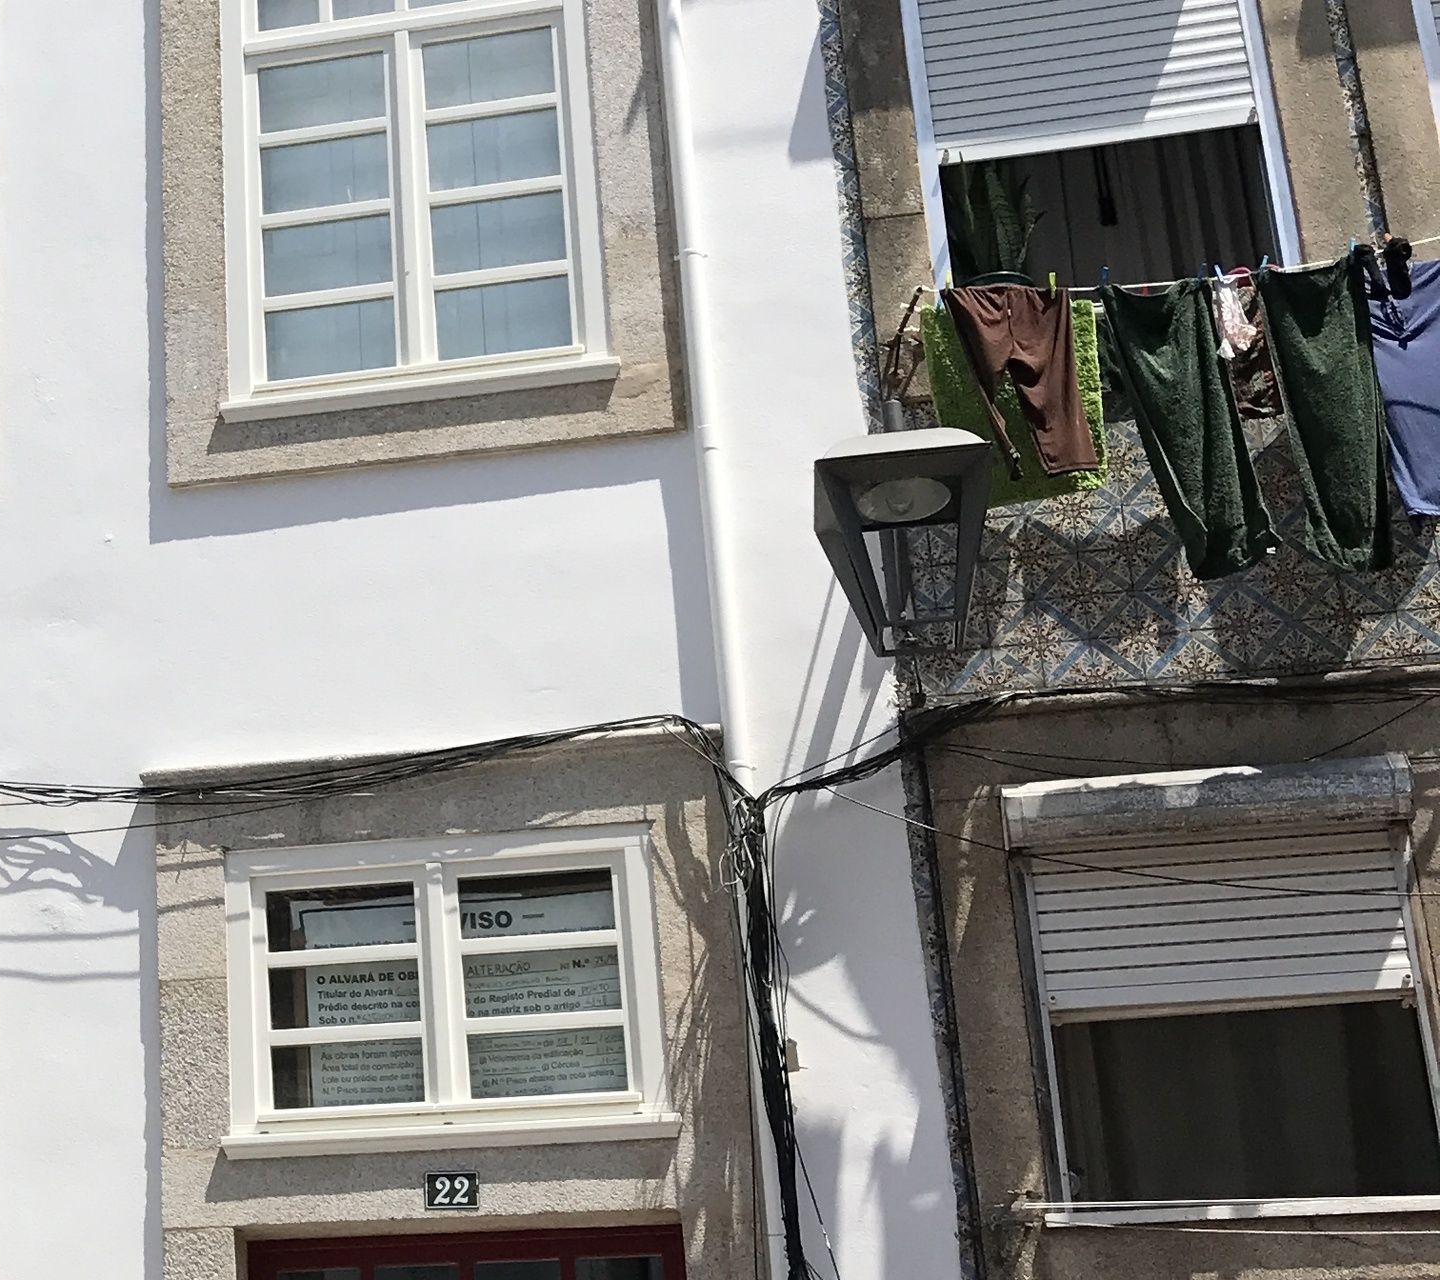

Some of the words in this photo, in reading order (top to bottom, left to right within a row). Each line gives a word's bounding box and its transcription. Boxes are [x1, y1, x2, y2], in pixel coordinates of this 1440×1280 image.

[317, 975, 326, 985] O
[329, 970, 375, 984] ALVARÁ
[378, 972, 395, 982] DE
[318, 989, 347, 999] Titular
[349, 989, 361, 998] do
[473, 995, 485, 1004] do
[489, 993, 524, 1005] Registo
[527, 989, 561, 1000] Predial
[564, 988, 576, 997] de
[351, 1000, 389, 1011] descrito
[391, 1001, 403, 1009] na
[492, 1005, 521, 1016] matriz
[523, 1003, 542, 1013] sob
[544, 1004, 551, 1012] o
[553, 1000, 581, 1013] artigo
[319, 1015, 338, 1025] Sob
[340, 1016, 347, 1024] o
[433, 1176, 470, 1205] 22
